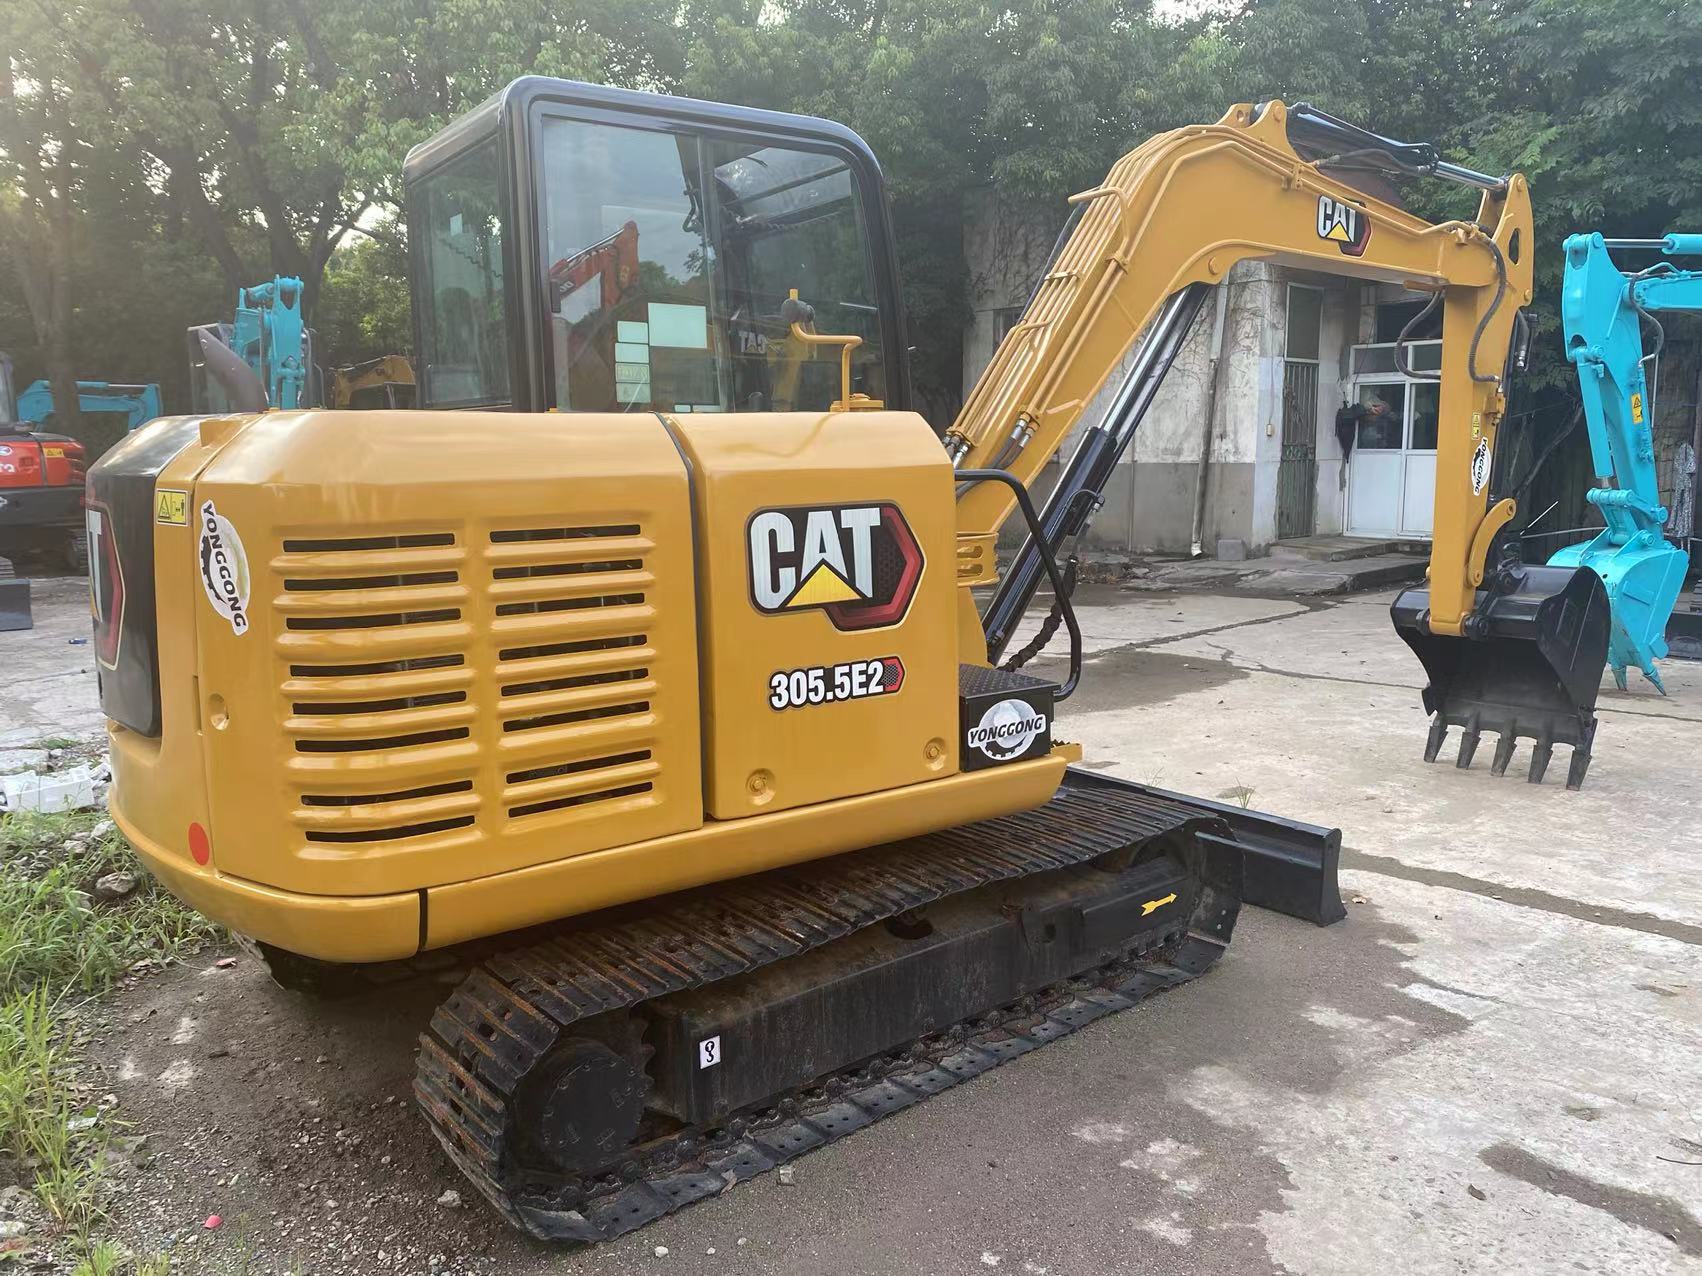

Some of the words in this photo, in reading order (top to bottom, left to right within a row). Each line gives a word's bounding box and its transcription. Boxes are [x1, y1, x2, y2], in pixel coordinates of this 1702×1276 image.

[1318, 195, 1356, 242] CAT
[203, 503, 247, 627] YONGGONG
[750, 507, 881, 609] CAT
[770, 661, 884, 708] 305.5E2
[969, 714, 1043, 743] YONGGONG
